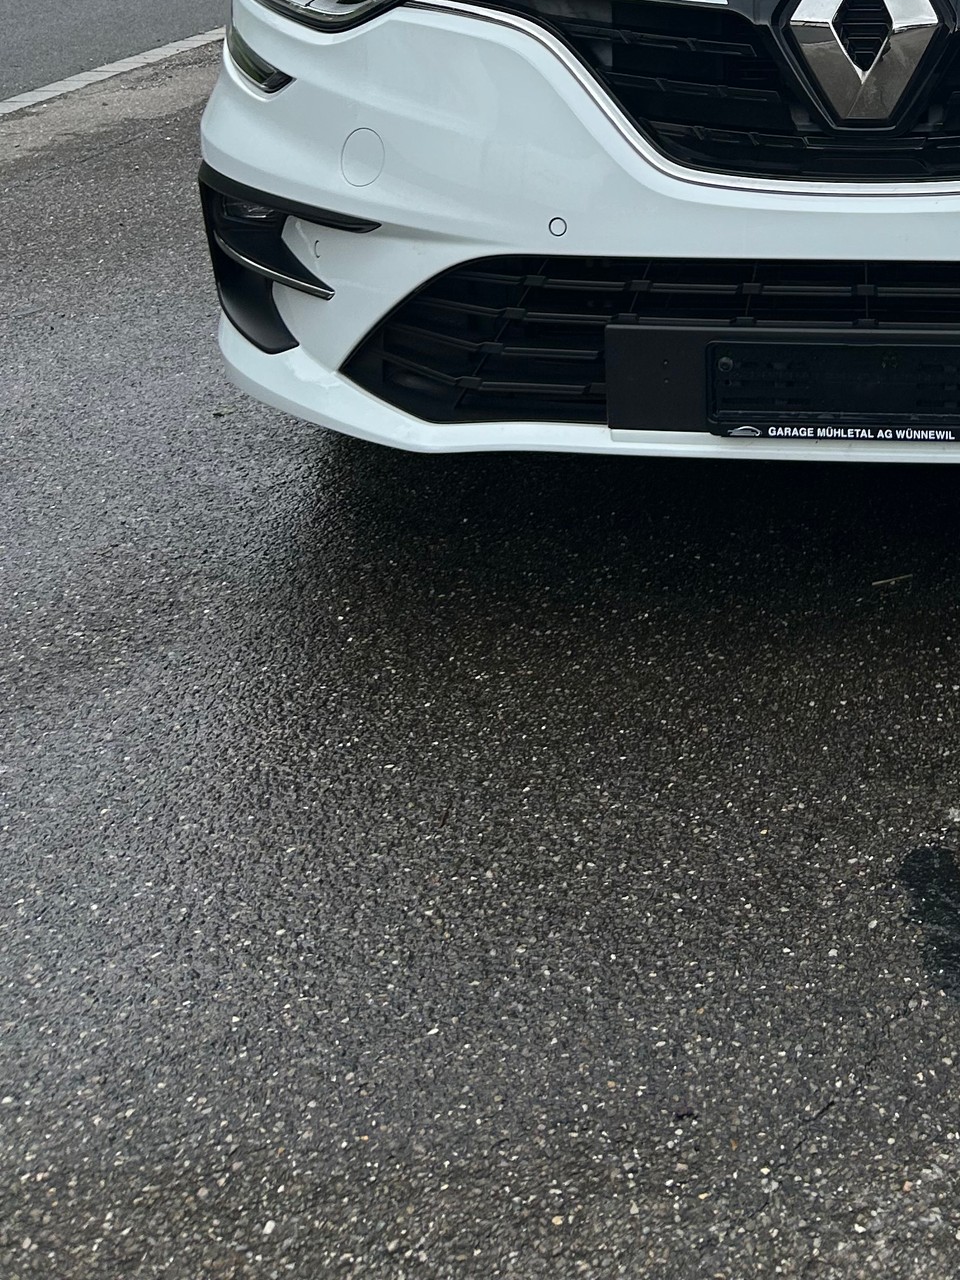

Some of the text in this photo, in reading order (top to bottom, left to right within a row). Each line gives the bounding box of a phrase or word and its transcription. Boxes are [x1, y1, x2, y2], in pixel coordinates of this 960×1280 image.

[767, 426, 956, 440] GARAGE MÜHLETAL AG WÜNNEWIL
